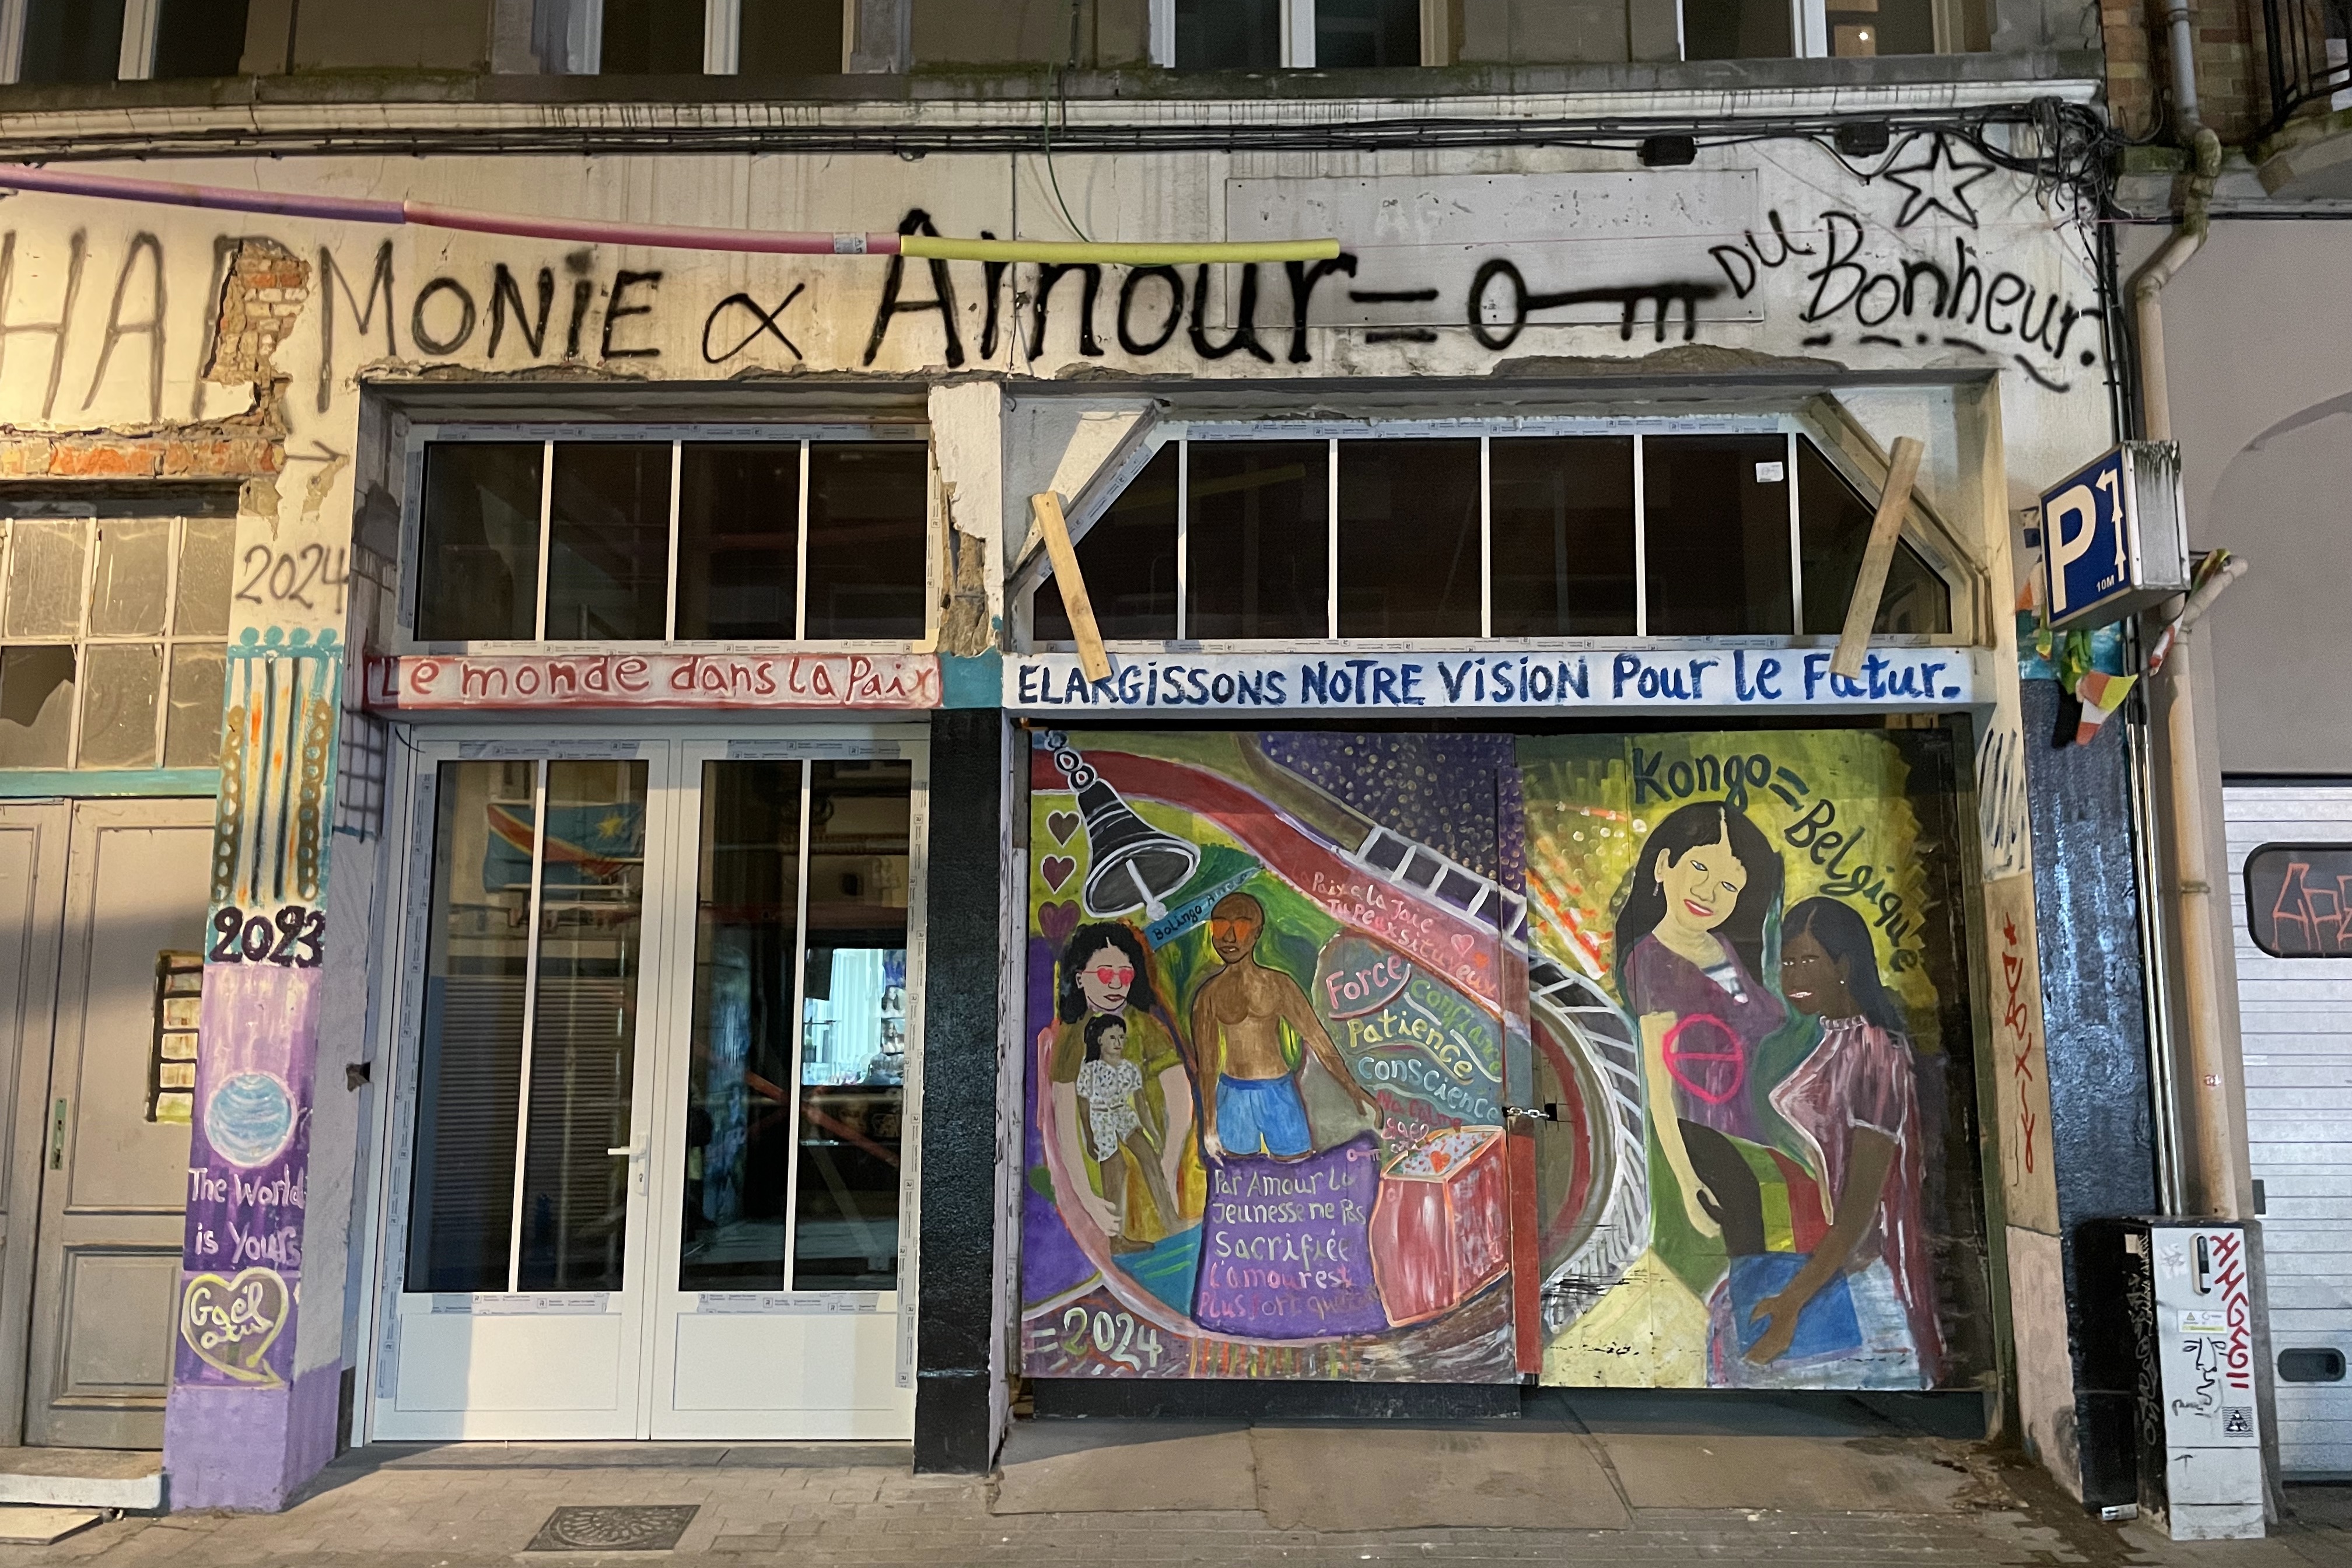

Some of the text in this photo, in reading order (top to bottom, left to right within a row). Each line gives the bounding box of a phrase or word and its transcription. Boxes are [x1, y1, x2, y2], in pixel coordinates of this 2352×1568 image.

[2046, 484, 2097, 614] P
[235, 542, 349, 615] 2024
[461, 656, 650, 696] monde
[1613, 653, 1719, 700] Pour
[1632, 748, 1772, 813] Kongo
[1325, 954, 1402, 1010] Force
[188, 1163, 306, 1209] The World
[1247, 1171, 1324, 1198] Amour
[1212, 1202, 1304, 1224] Jeunesse
[1308, 1202, 1335, 1220] ne
[195, 1221, 301, 1266] is Yours
[1062, 1307, 1163, 1371] 2024
